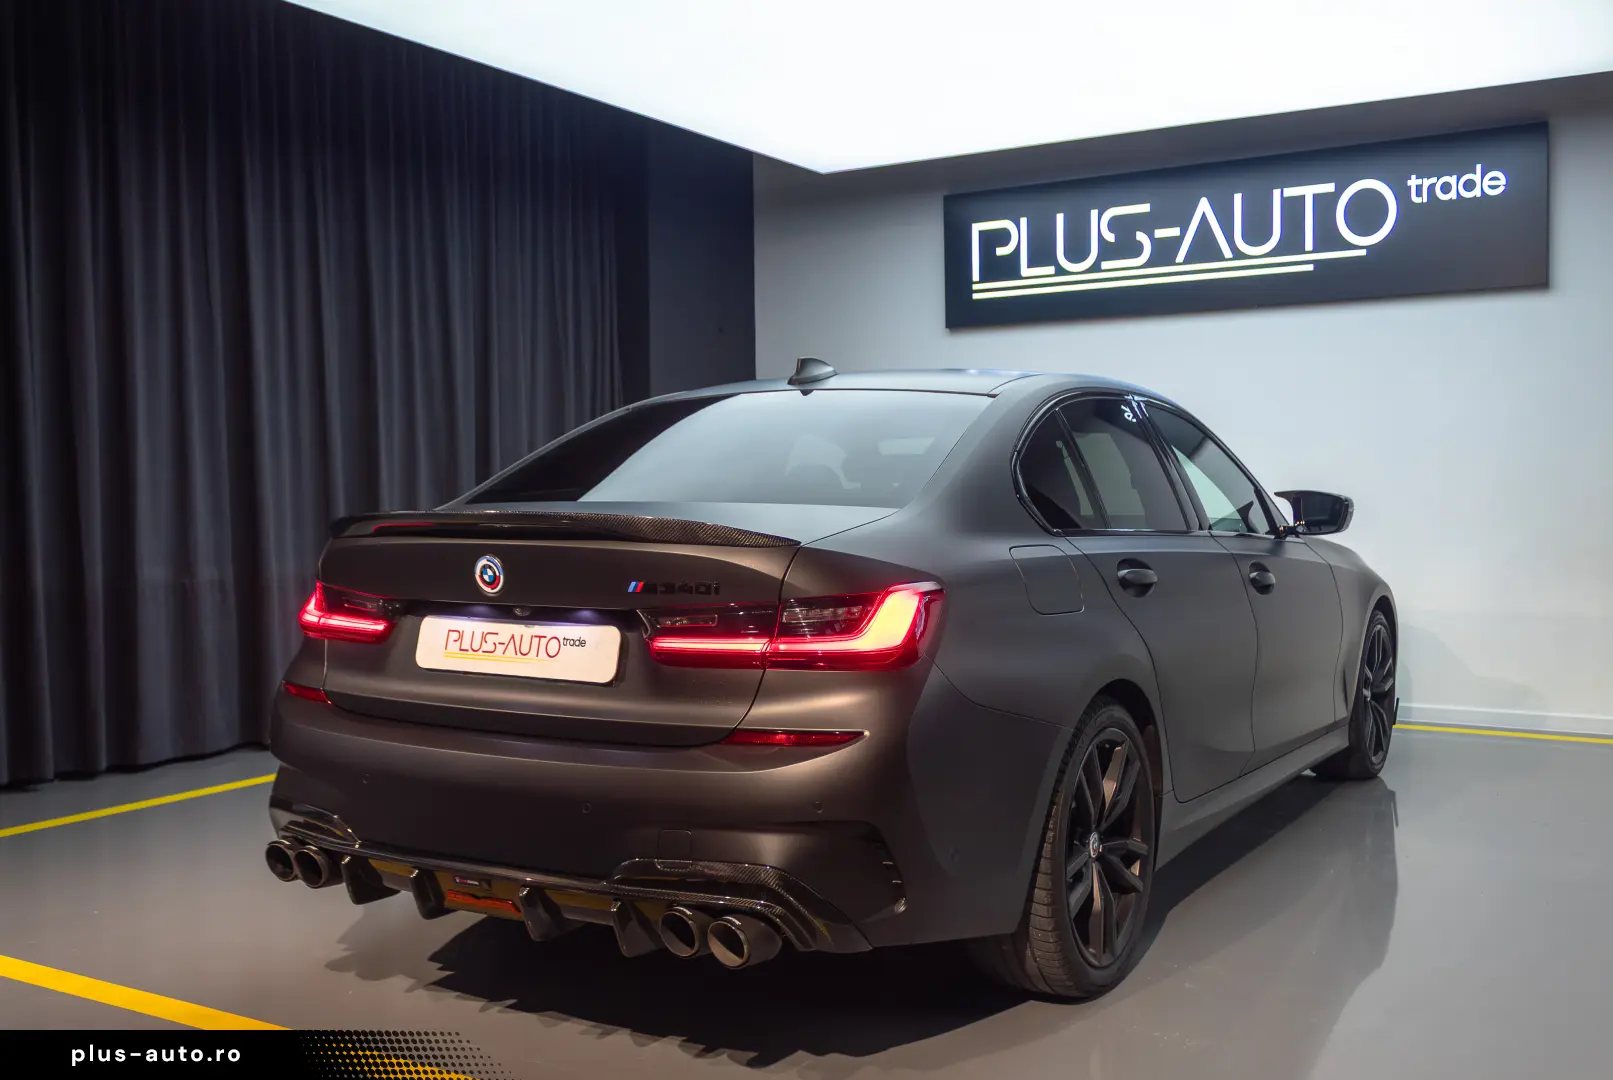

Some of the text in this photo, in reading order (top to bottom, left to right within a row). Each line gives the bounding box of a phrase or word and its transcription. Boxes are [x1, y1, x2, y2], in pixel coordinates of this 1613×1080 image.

[972, 164, 1507, 282] PLUS-AUTO trade
[445, 629, 587, 658] PLUS-AUTO trade
